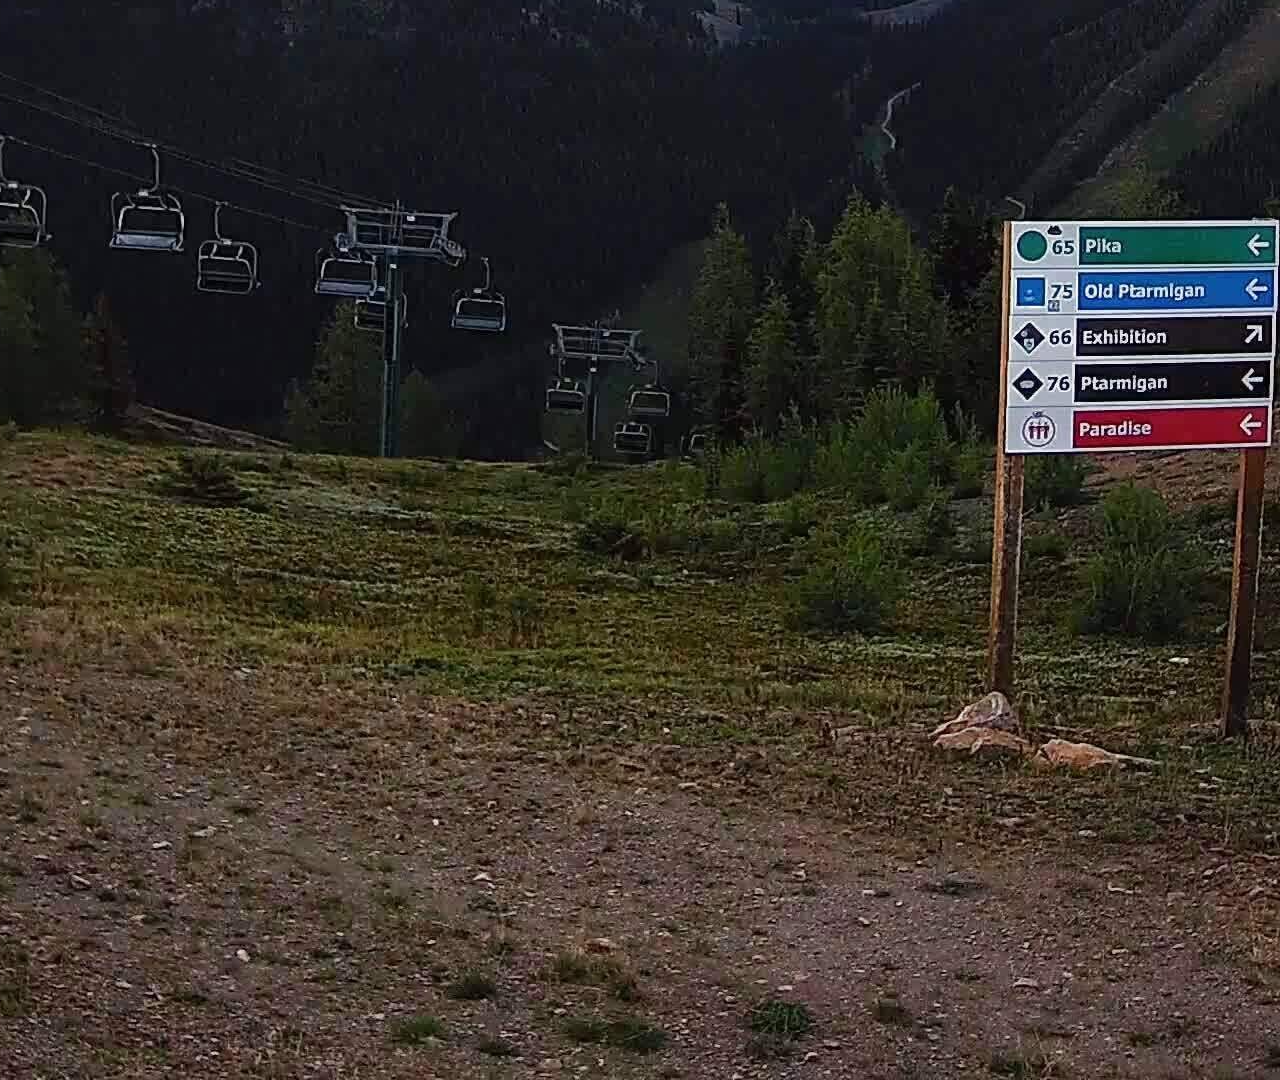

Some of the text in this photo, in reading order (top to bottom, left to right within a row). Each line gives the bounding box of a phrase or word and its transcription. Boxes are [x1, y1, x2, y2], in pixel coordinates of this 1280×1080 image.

[1052, 238, 1122, 255] 65 Pika
[1051, 283, 1205, 301] 75 Old Ptarmigan
[1049, 328, 1167, 345] 66 Exhibition
[1047, 375, 1168, 393] 76 Ptarmigan
[1079, 420, 1152, 437] Paradise
